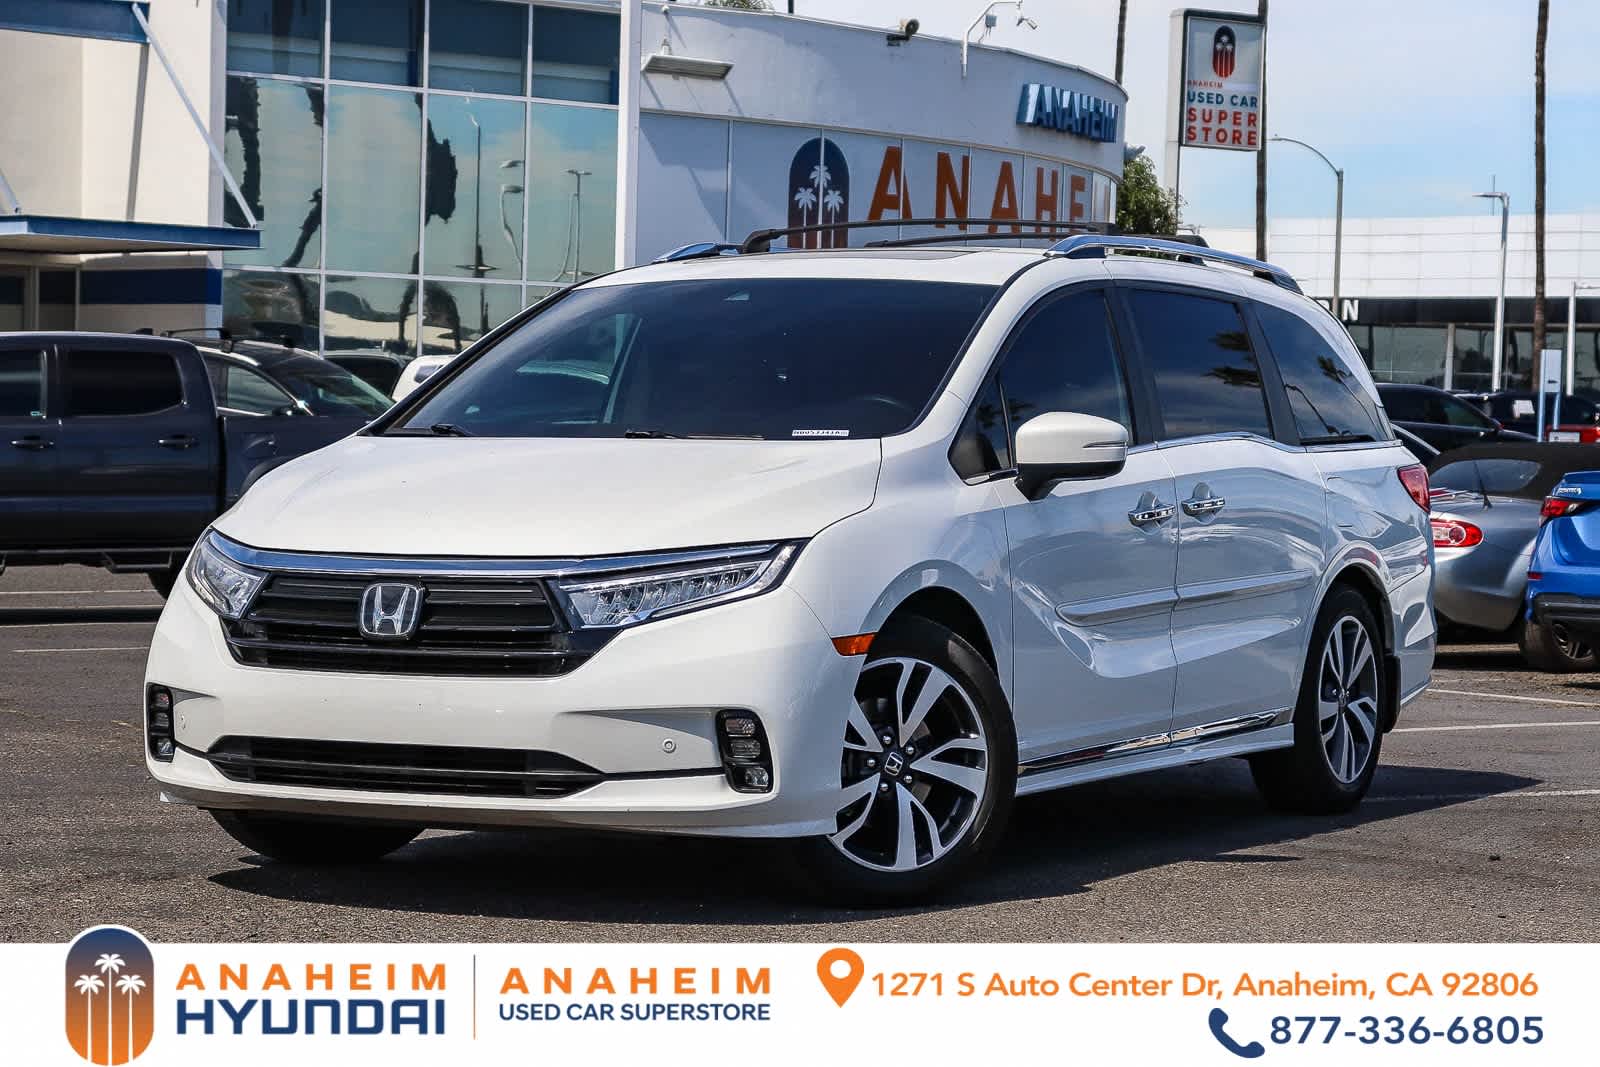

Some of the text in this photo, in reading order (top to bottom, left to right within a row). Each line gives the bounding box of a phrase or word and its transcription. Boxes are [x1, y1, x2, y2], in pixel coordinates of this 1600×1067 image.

[1187, 91, 1258, 108] USED CAR
[1016, 83, 1119, 143] ANAHEIM
[1188, 107, 1257, 127] SUPER
[1187, 126, 1257, 146] STORE
